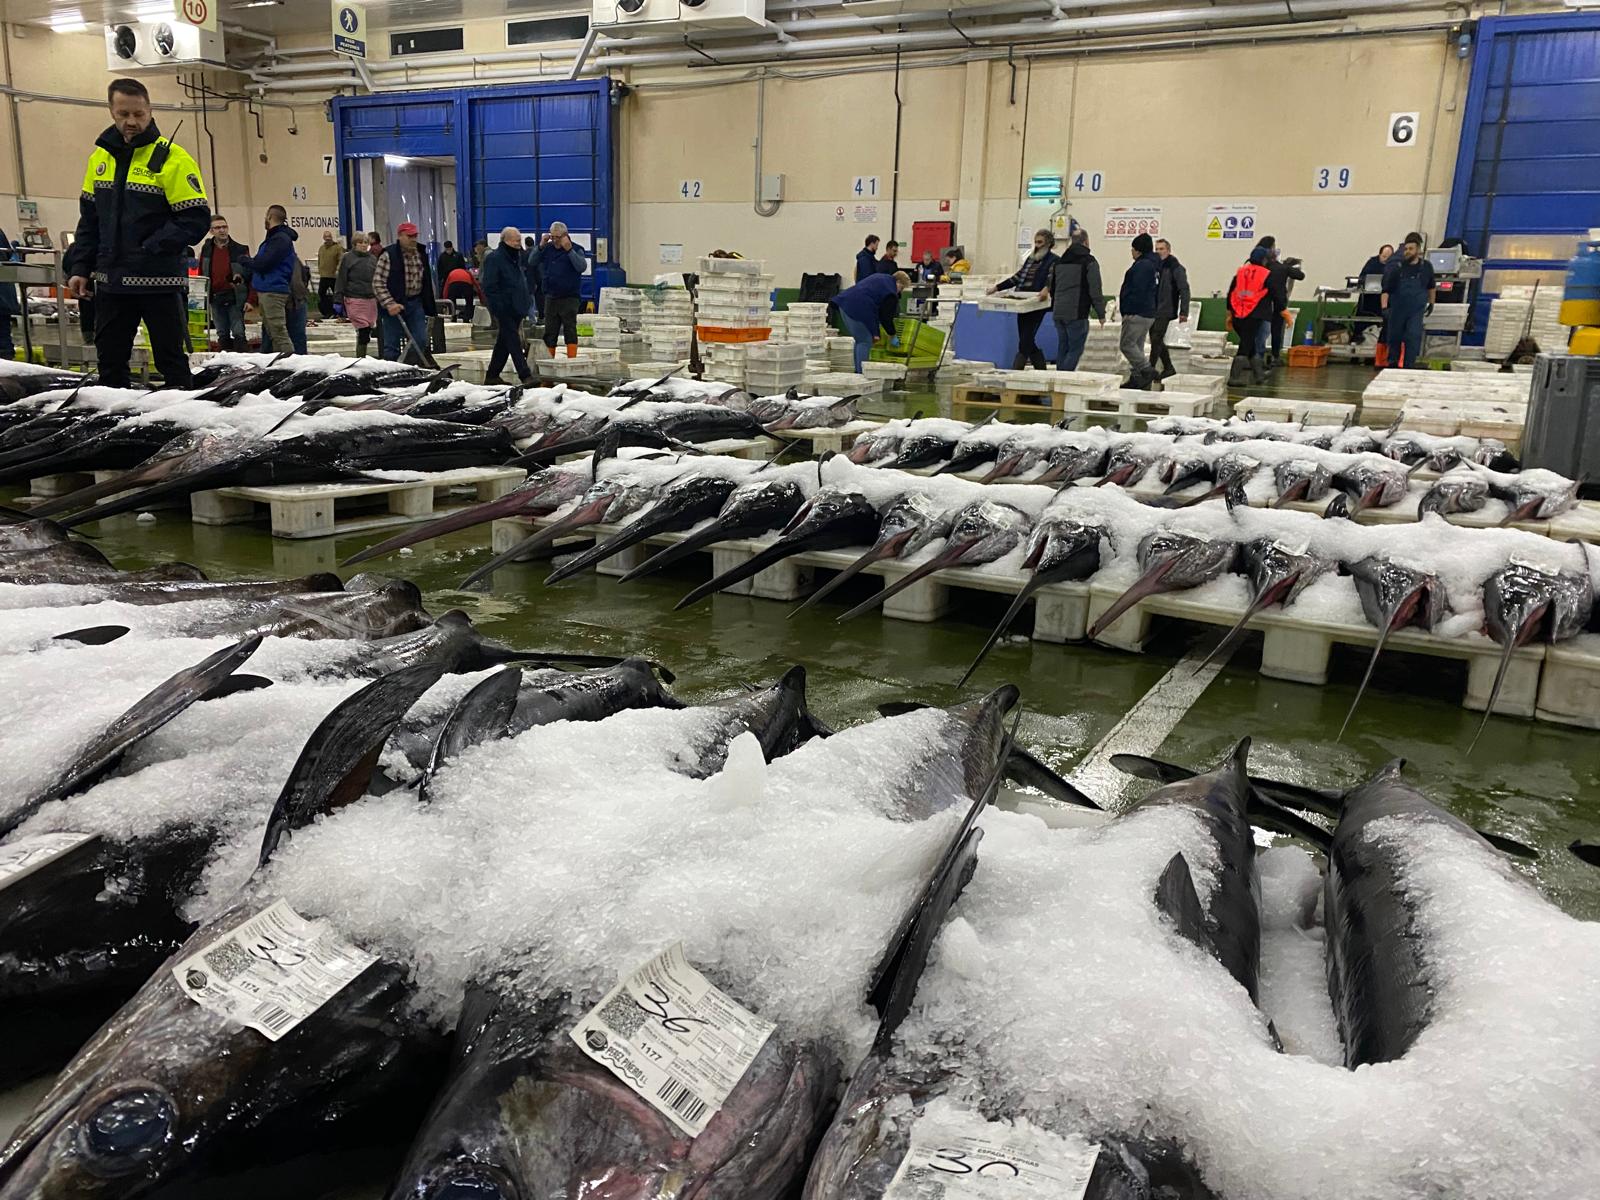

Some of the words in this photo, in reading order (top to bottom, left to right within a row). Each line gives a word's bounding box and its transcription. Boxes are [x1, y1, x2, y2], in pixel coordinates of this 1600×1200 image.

[187, 1, 203, 17] 10
[1392, 115, 1414, 143] 6
[323, 156, 333, 174] 7
[854, 178, 876, 196] 41
[1074, 172, 1102, 192] 40
[1318, 168, 1350, 189] 39
[681, 181, 701, 198] 42
[291, 216, 340, 228] ESTACIONAIS
[240, 981, 260, 993] 1174
[635, 981, 709, 1033] 36
[605, 1045, 625, 1062] PEREZ
[640, 1042, 662, 1061] 1177
